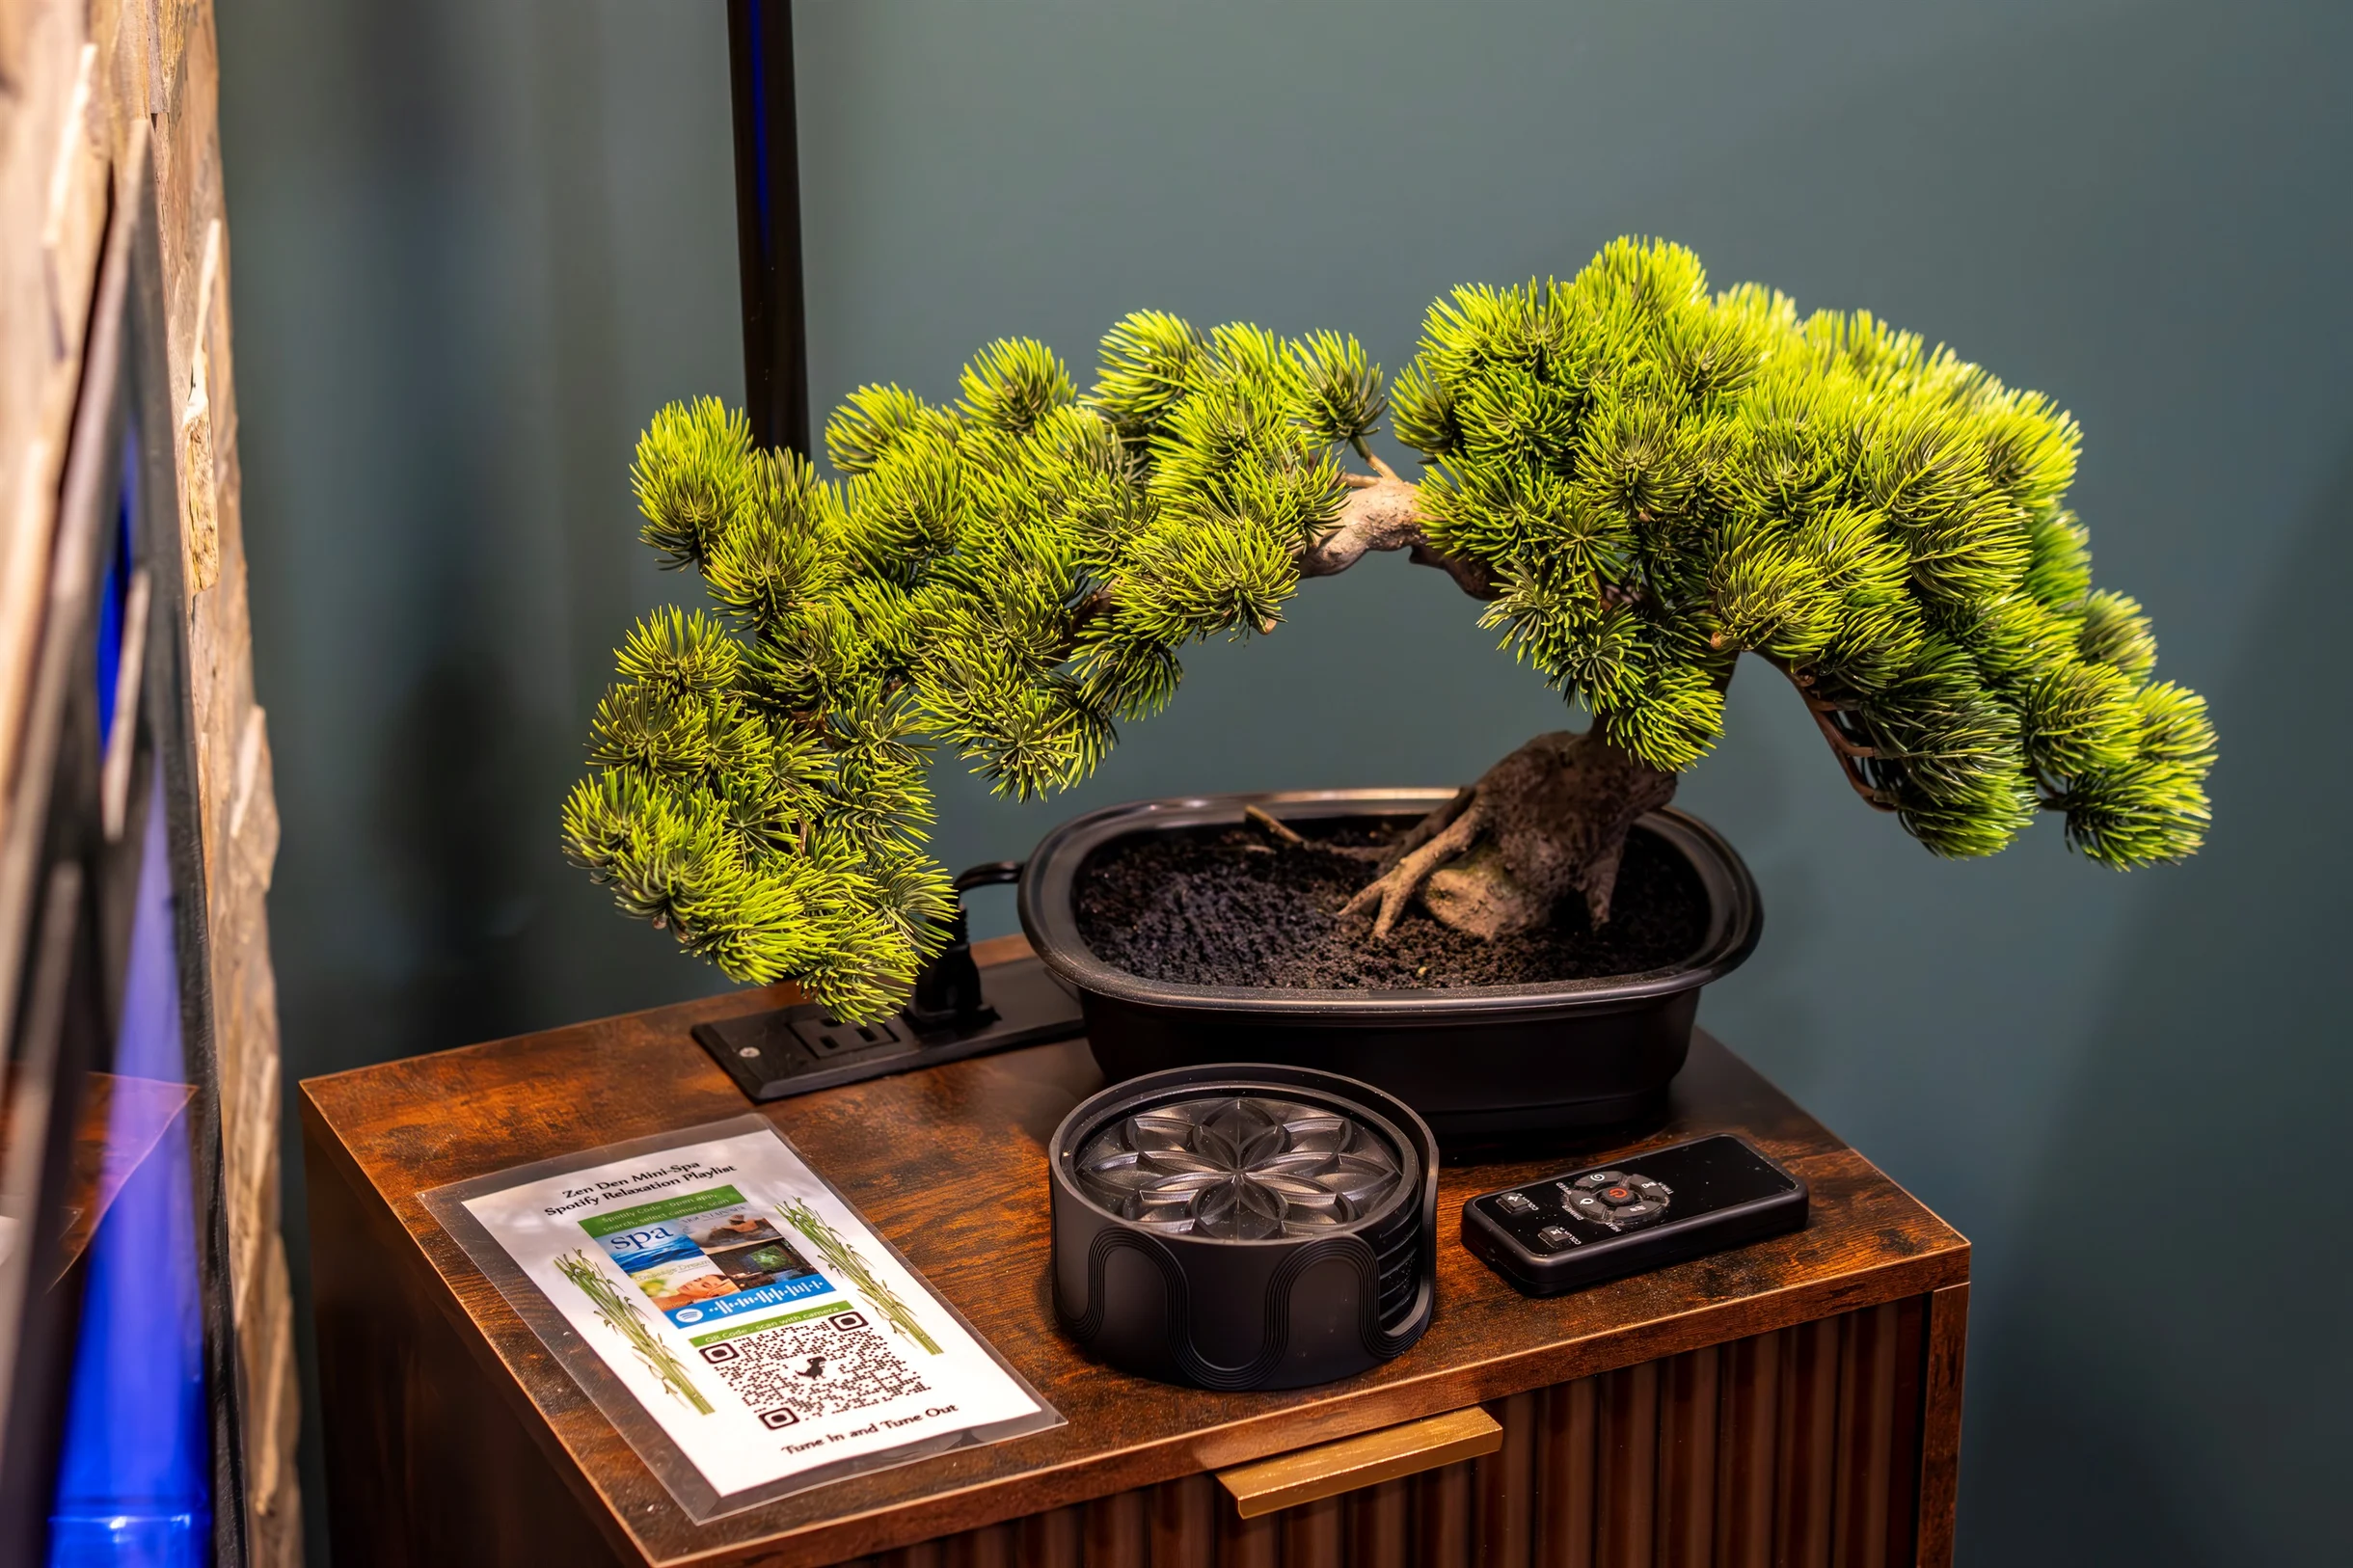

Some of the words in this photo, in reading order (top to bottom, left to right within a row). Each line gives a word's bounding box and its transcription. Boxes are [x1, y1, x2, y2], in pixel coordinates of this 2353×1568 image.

[544, 1196, 600, 1216] Spotify
[604, 1178, 681, 1201] Relaxation
[682, 1165, 737, 1183] Playlist
[562, 1187, 593, 1199] Zen
[595, 1178, 629, 1190] Den
[632, 1161, 700, 1182] Mini-Spa
[601, 1209, 636, 1224] Spotify
[636, 1204, 662, 1215] Code
[669, 1196, 694, 1208] open
[639, 1212, 666, 1225] select
[709, 1199, 730, 1207] scan
[610, 1226, 674, 1250] spa
[677, 1259, 711, 1271] Dream
[705, 1335, 721, 1343] QR
[721, 1326, 748, 1338] Code
[755, 1320, 779, 1331] scan
[779, 1314, 801, 1325] with
[802, 1307, 839, 1318] camera
[781, 1439, 825, 1455] Tune
[825, 1433, 845, 1443] In
[850, 1423, 879, 1438] and
[879, 1415, 923, 1430] Tune
[925, 1404, 960, 1418] Out
